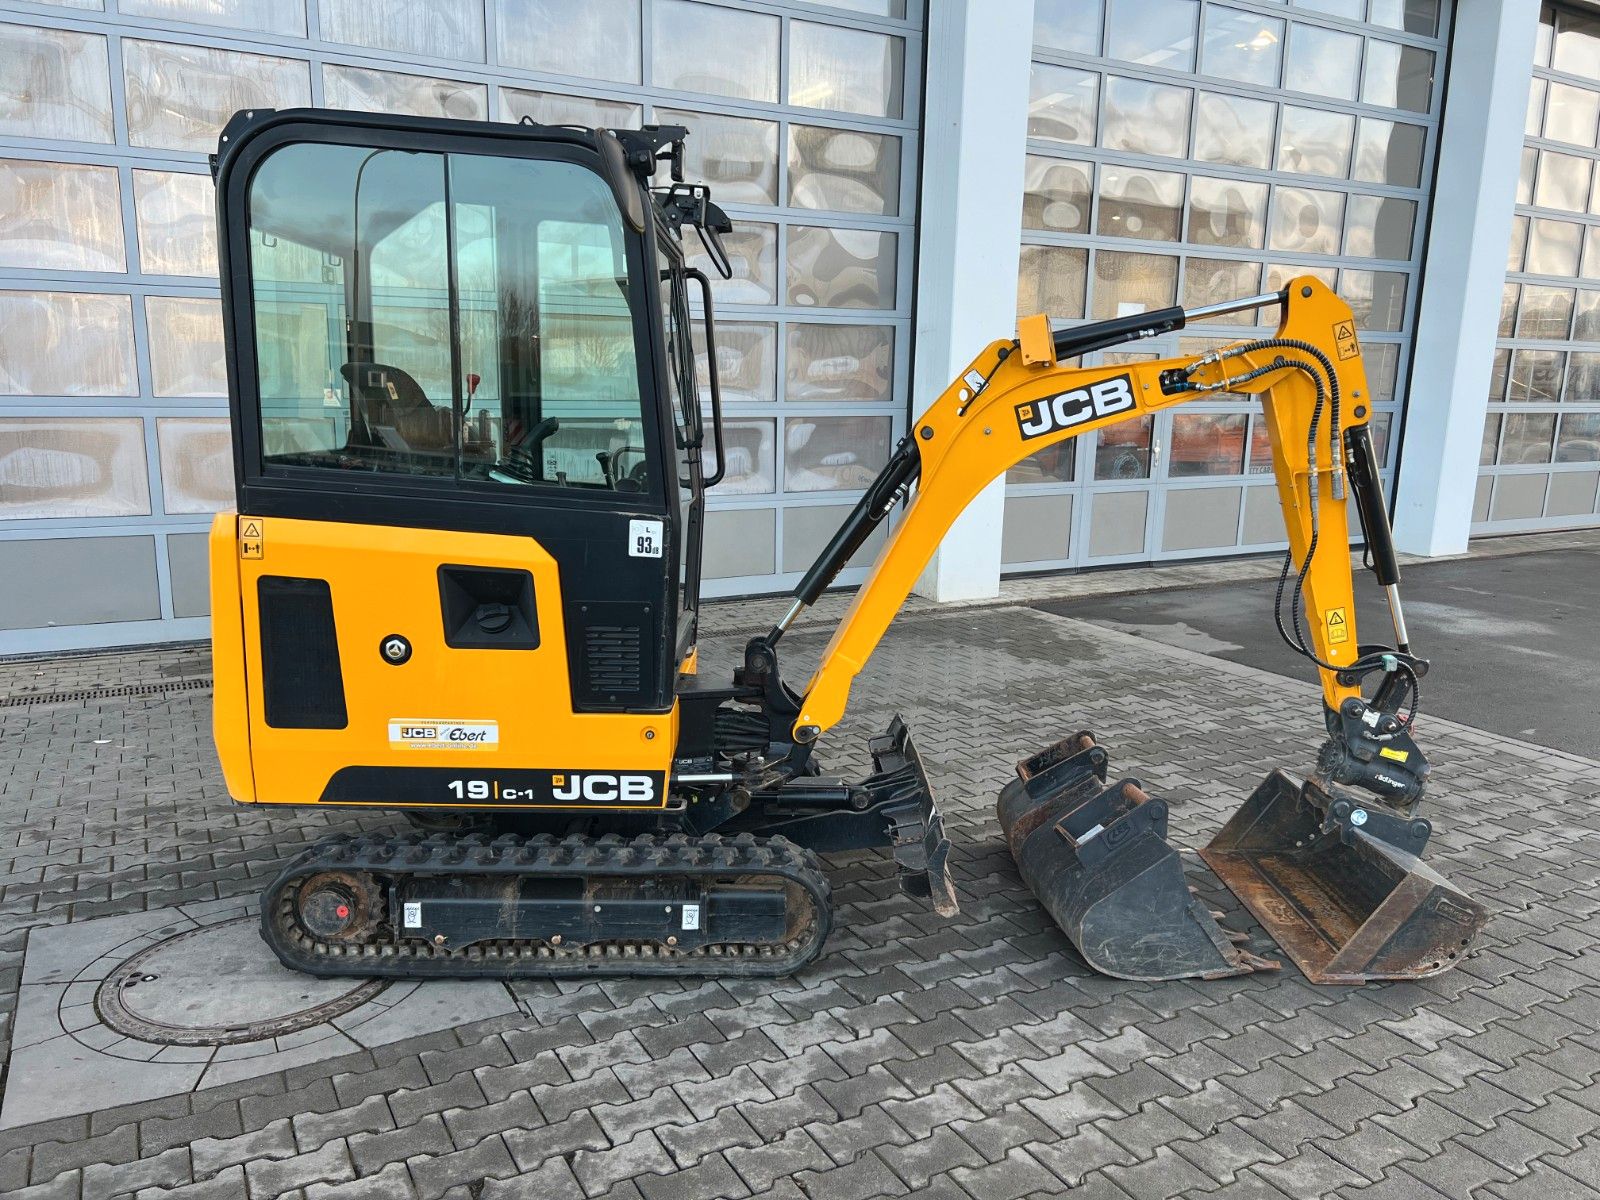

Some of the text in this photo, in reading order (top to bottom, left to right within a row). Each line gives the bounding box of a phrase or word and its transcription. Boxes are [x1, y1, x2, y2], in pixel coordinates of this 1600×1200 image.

[1021, 378, 1133, 436] JCB
[637, 536, 652, 554] 93
[402, 728, 436, 738] JCB
[449, 728, 487, 741] Ebert
[447, 780, 489, 800] 19
[552, 774, 655, 801] JCB
